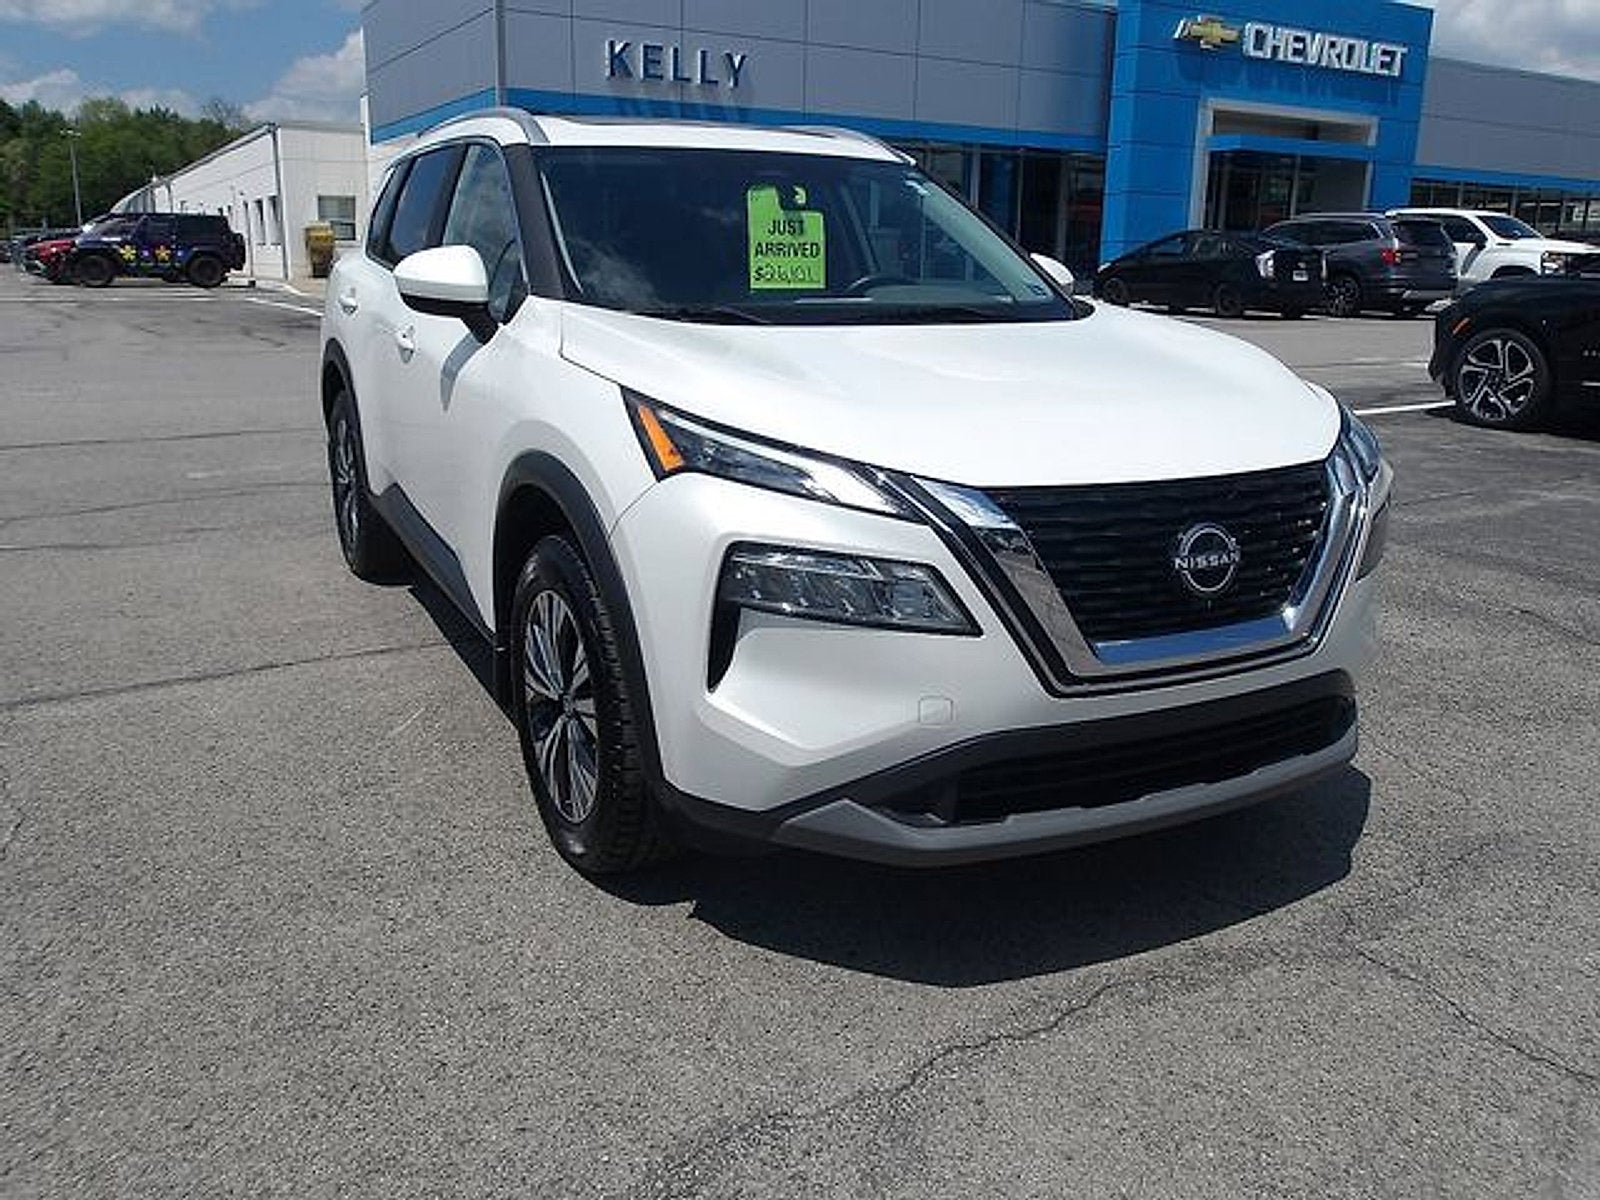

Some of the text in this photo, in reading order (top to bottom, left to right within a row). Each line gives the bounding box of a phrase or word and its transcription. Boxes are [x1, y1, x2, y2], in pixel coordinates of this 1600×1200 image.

[1243, 22, 1408, 77] CHEVROLET
[605, 39, 747, 88] KELLY
[767, 219, 804, 236] JUST
[755, 242, 821, 259] ARRIVED
[1174, 551, 1240, 569] NISSAN
